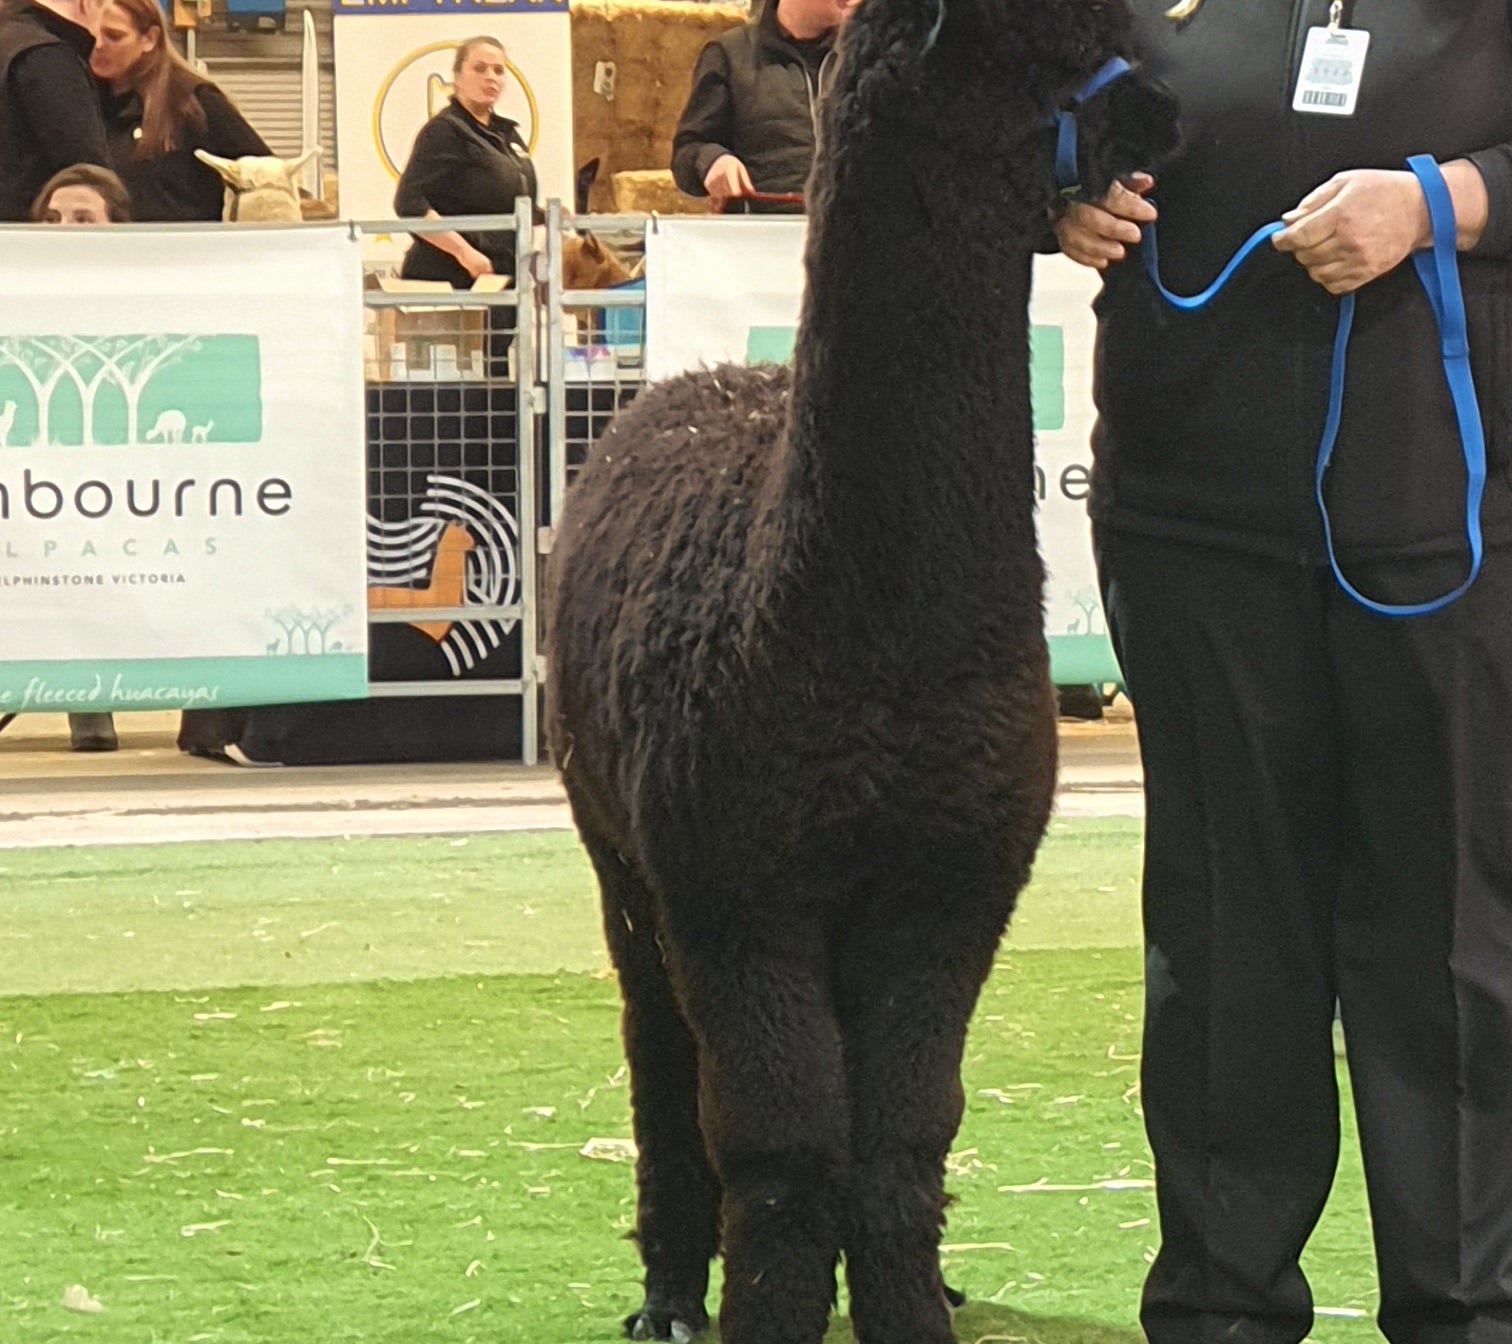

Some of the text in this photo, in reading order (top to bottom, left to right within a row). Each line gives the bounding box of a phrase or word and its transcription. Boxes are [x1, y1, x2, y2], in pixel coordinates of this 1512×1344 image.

[0, 573, 186, 587] LPHINSTONE VICTORIA
[21, 673, 101, 708] fleeced
